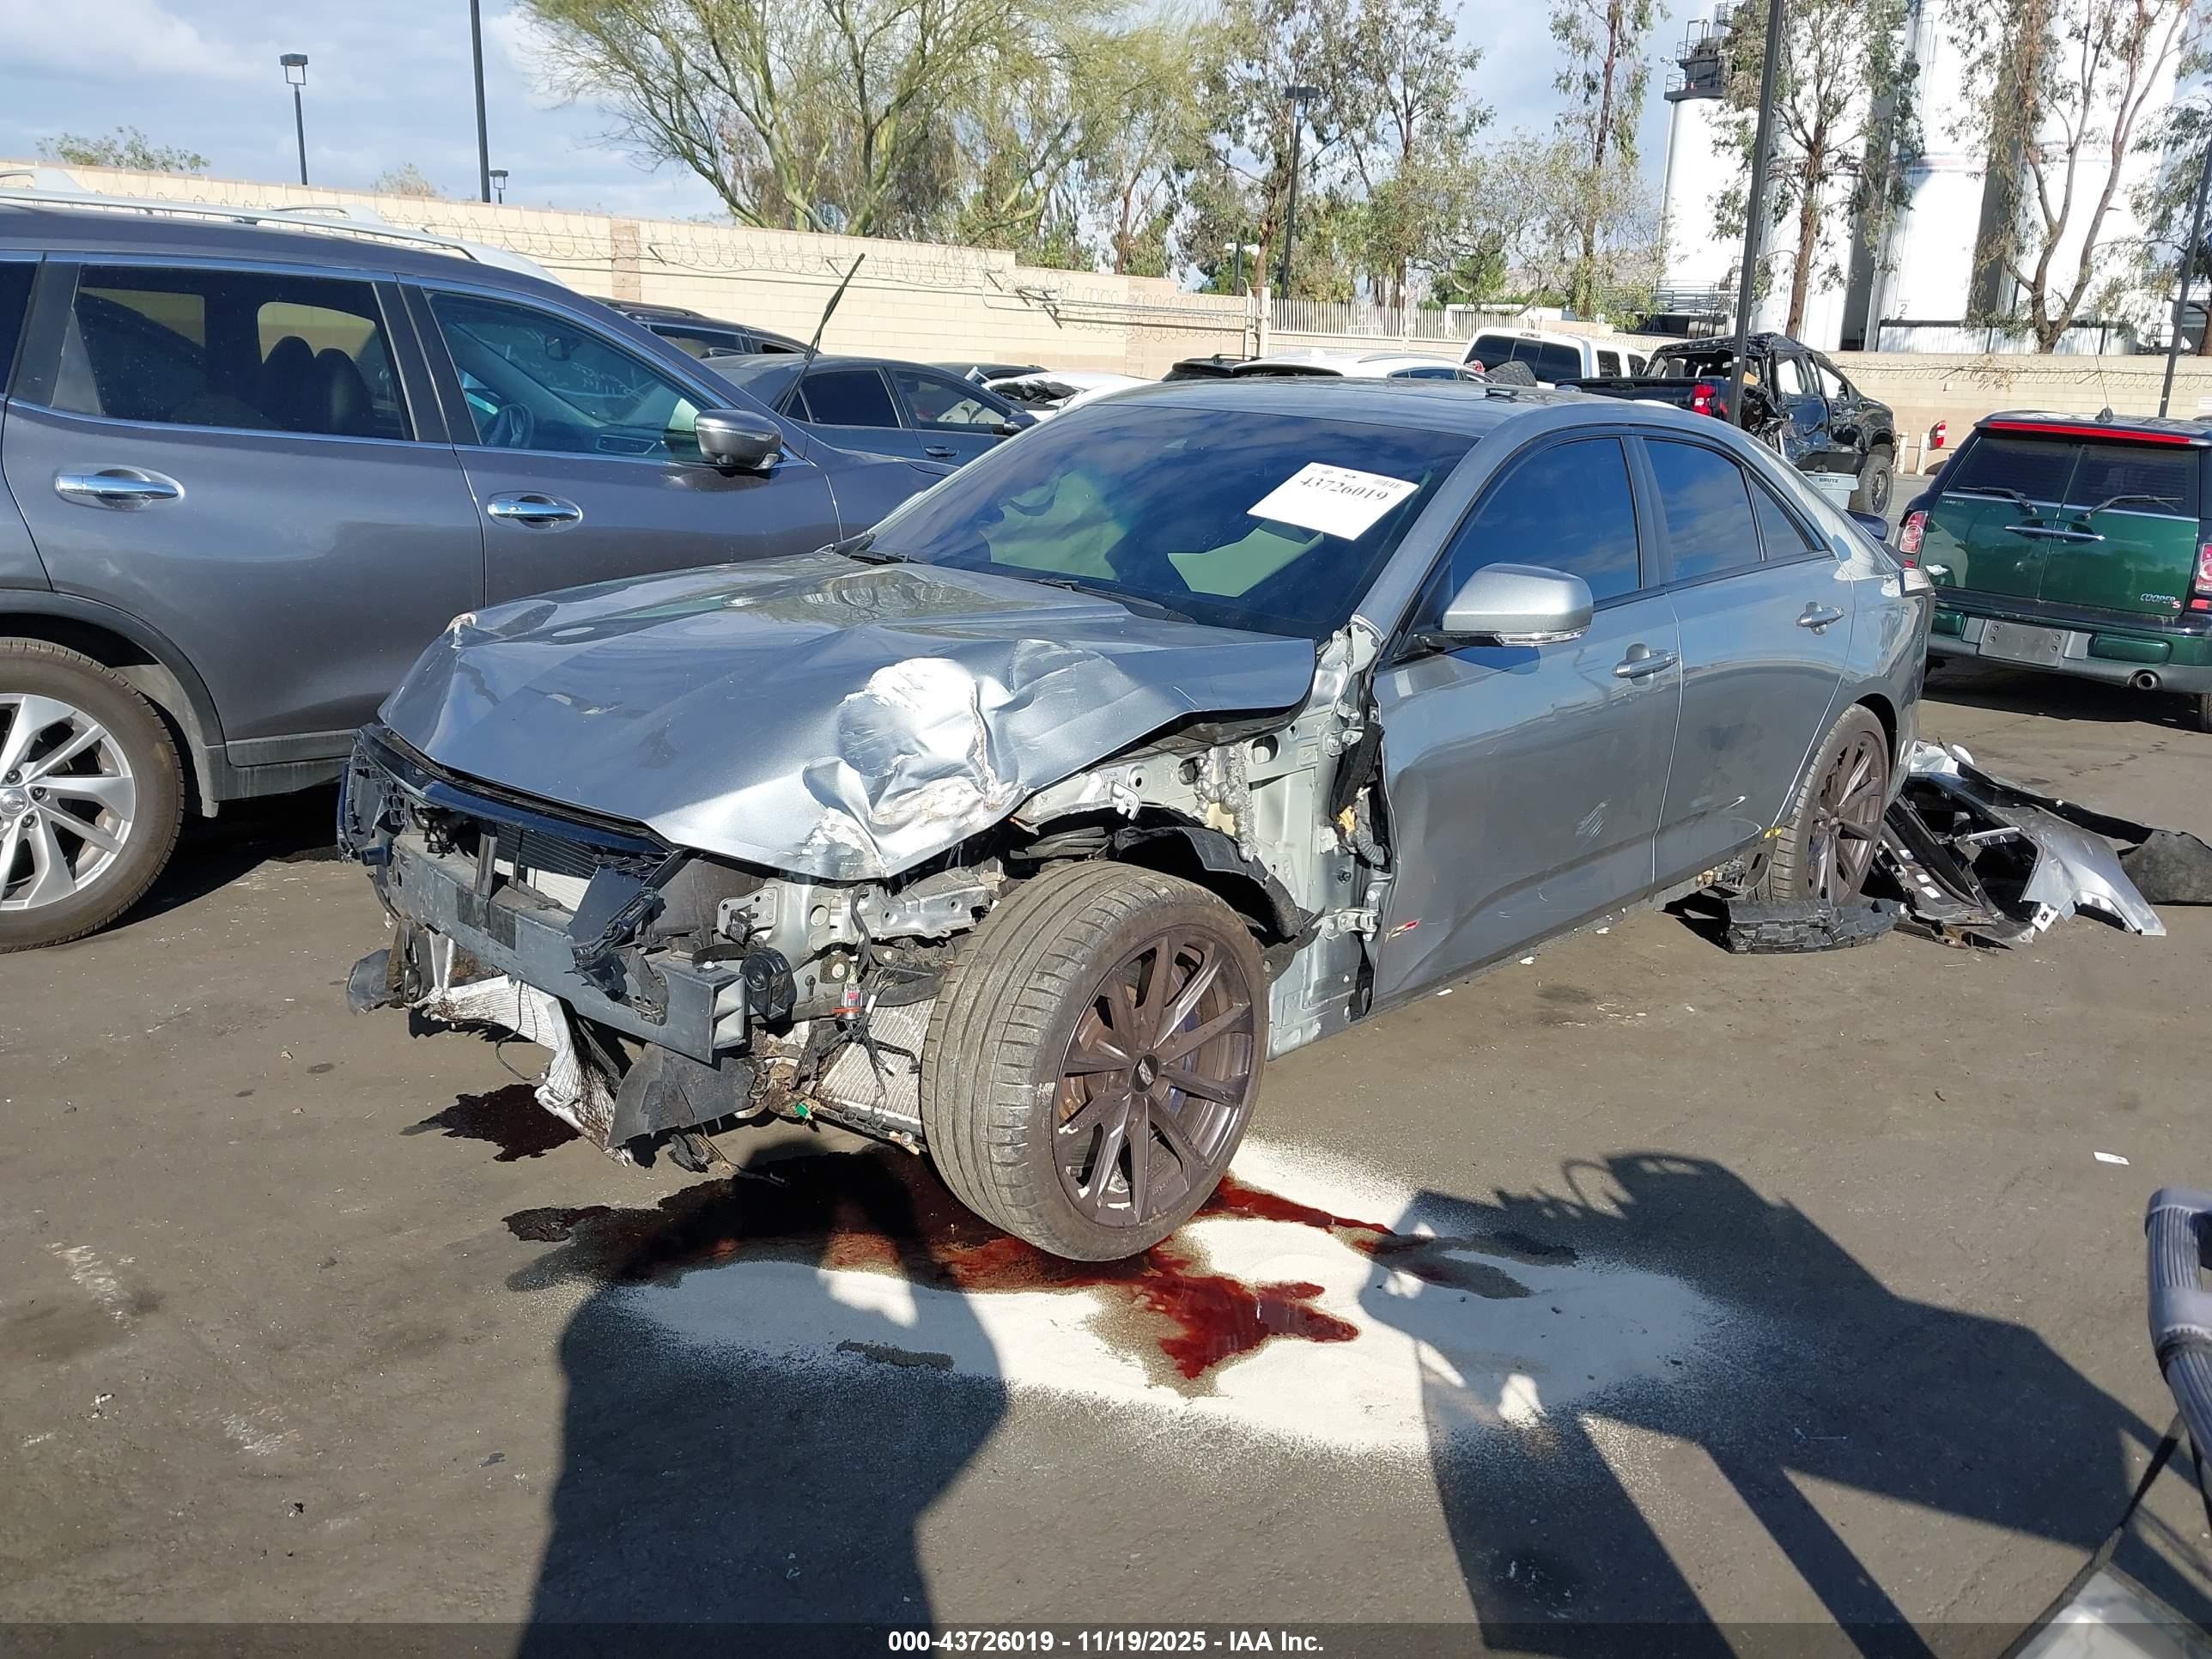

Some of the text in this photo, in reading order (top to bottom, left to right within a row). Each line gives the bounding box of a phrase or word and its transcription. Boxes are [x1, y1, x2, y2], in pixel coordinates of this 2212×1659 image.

[1899, 303, 1908, 315] 2
[1299, 476, 1389, 501] 43726019
[2139, 592, 2181, 609] COOPER S
